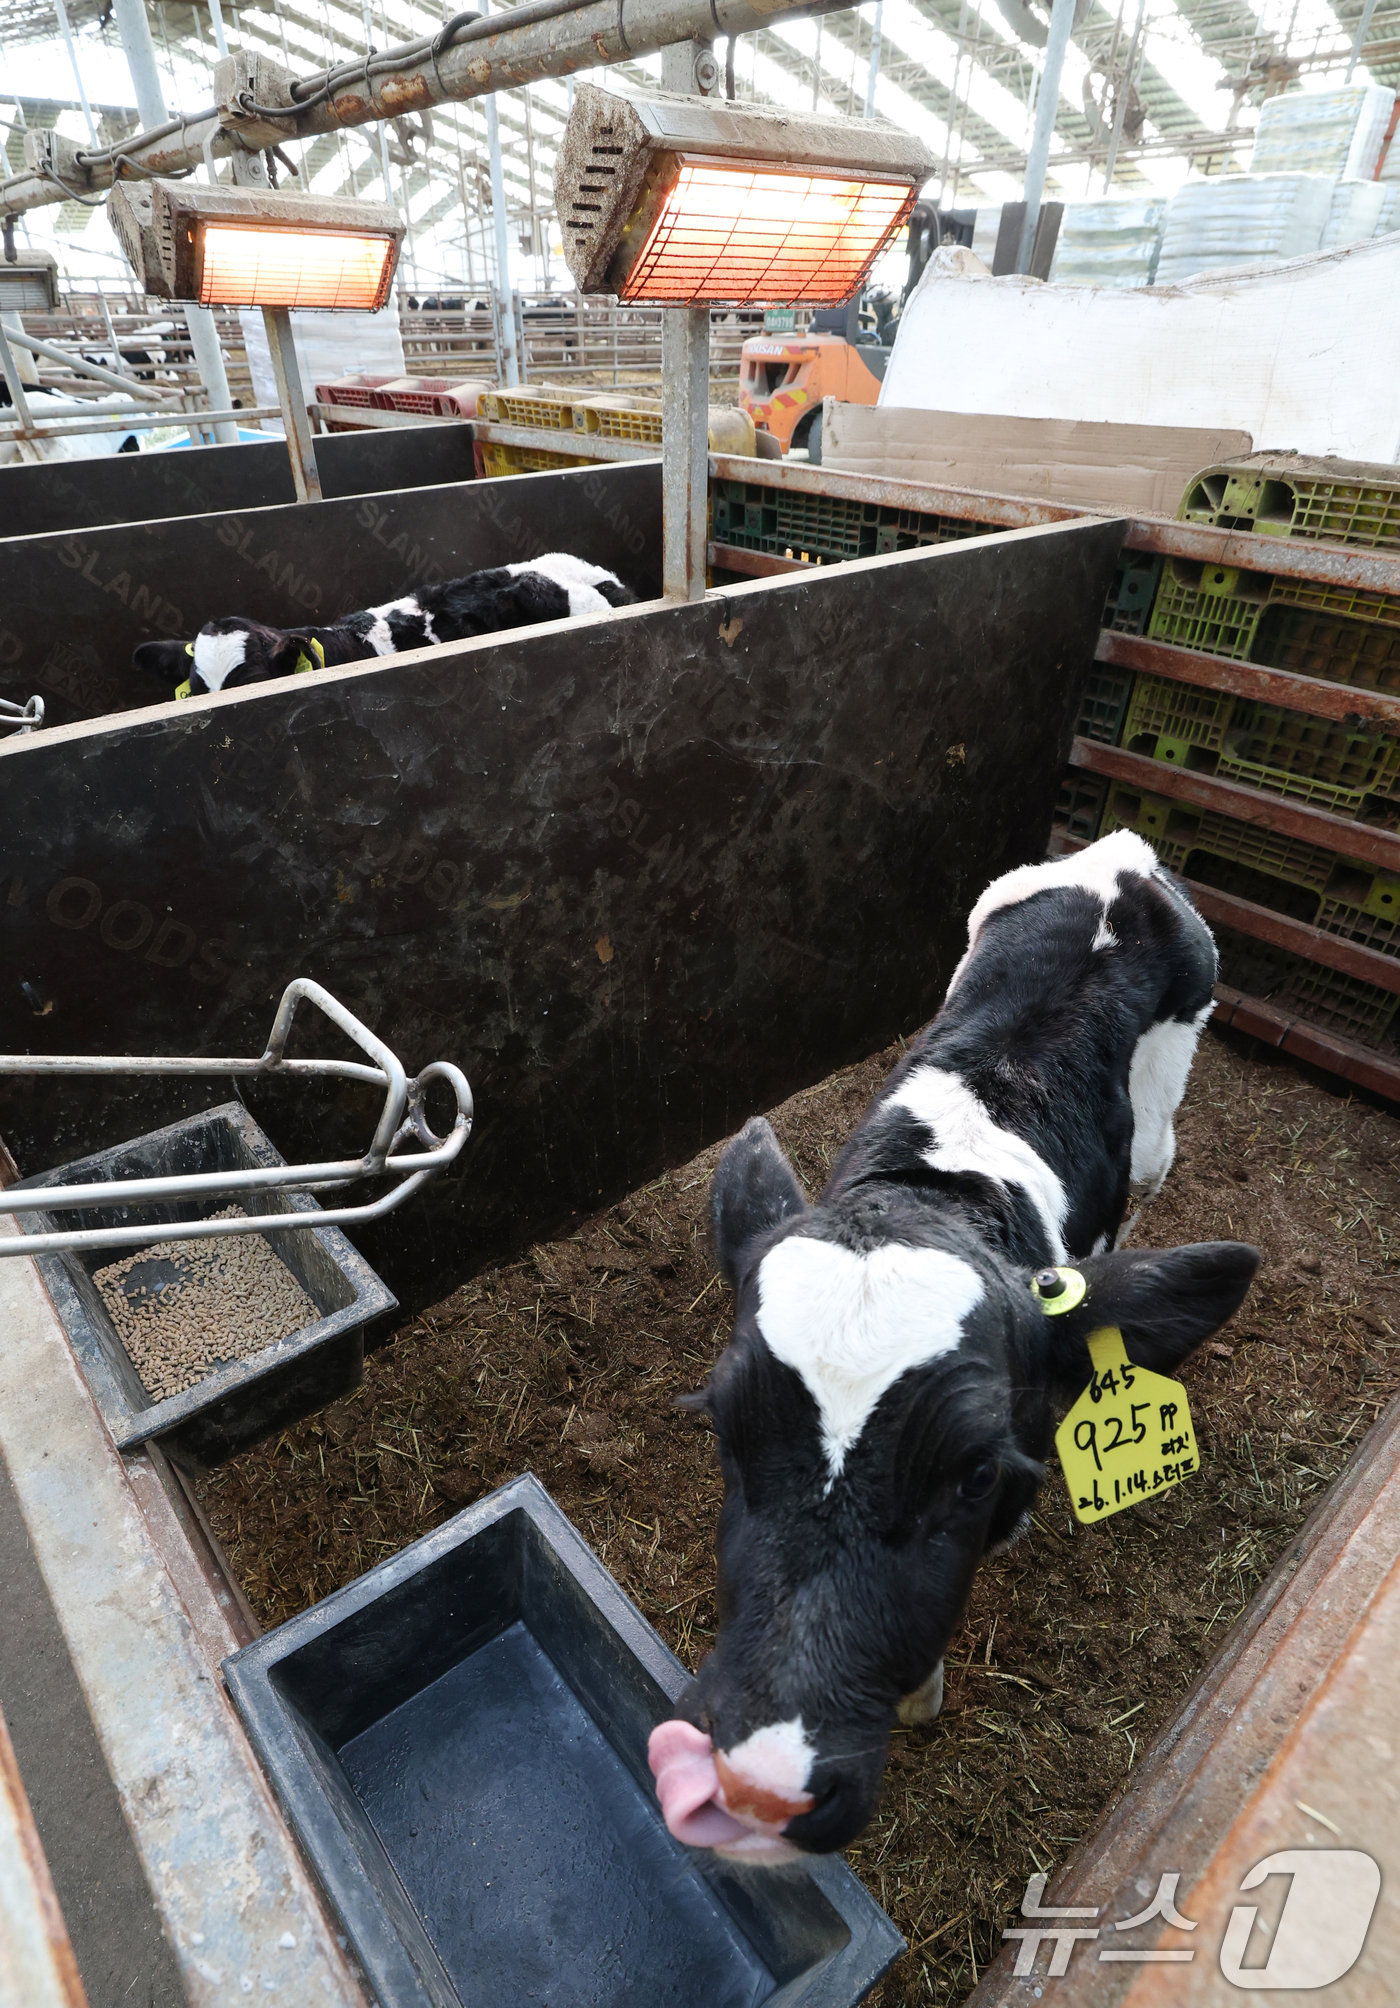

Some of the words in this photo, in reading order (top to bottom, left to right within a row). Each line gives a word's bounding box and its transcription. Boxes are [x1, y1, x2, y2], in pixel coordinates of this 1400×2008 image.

[572, 473, 646, 554] SLAND
[196, 517, 322, 609] SLAND
[1090, 1364, 1136, 1404] 645
[1074, 1403, 1150, 1471] 925
